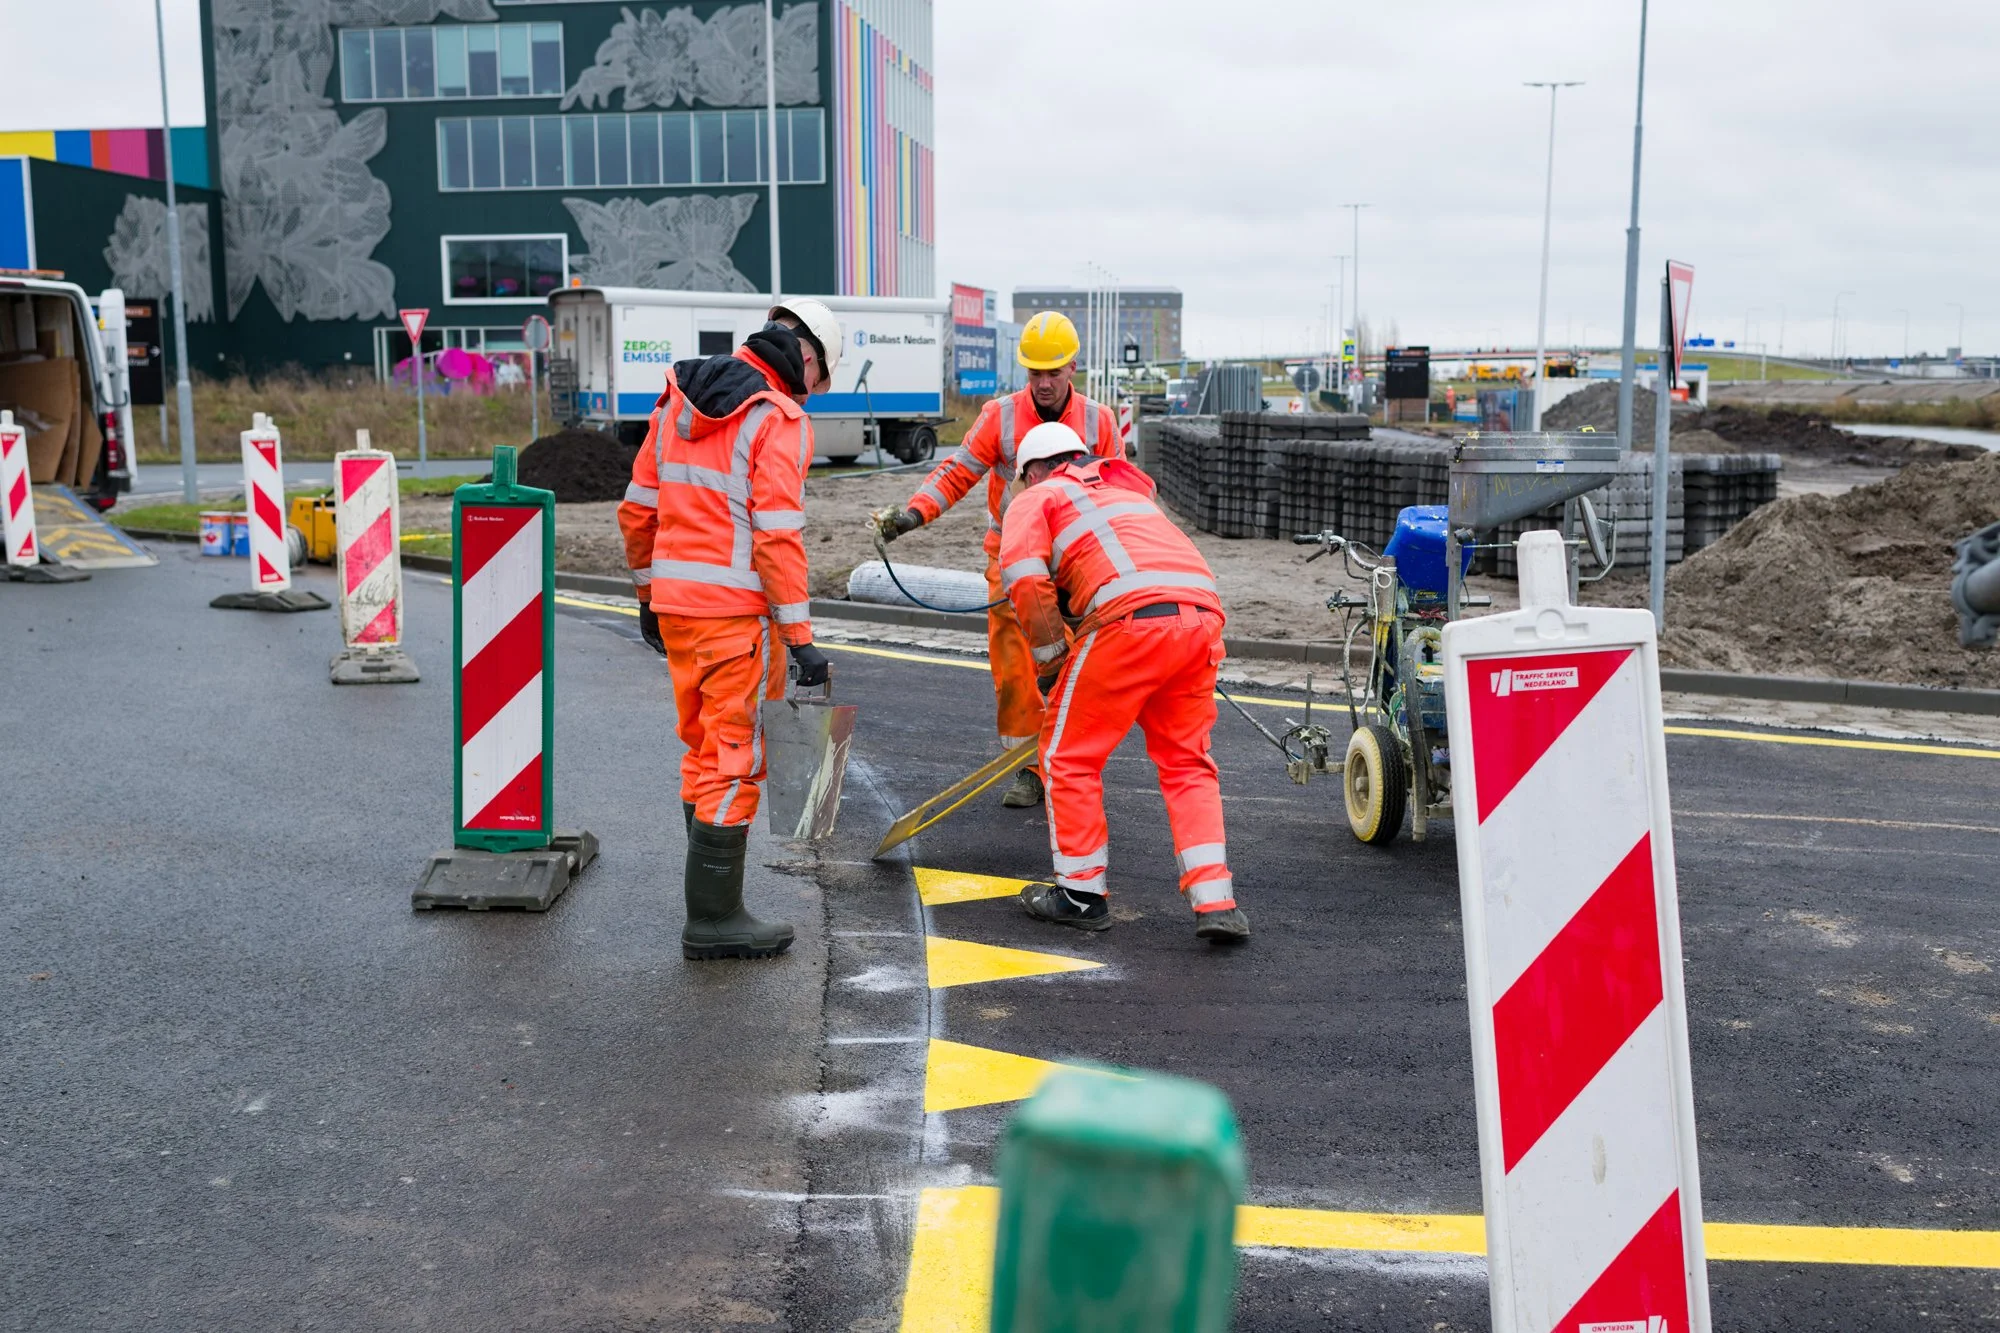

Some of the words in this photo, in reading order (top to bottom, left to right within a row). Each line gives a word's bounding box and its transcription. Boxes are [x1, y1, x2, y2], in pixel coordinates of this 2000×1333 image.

[869, 334, 901, 344] Ballast
[903, 335, 936, 345] Nedam
[623, 352, 672, 363] EMISSIE
[1515, 672, 1545, 681] TRAFFIC
[1546, 670, 1574, 679] SERVICE
[1523, 679, 1567, 689] NEDERLAND
[1591, 1324, 1635, 1332] NEDERLAND
